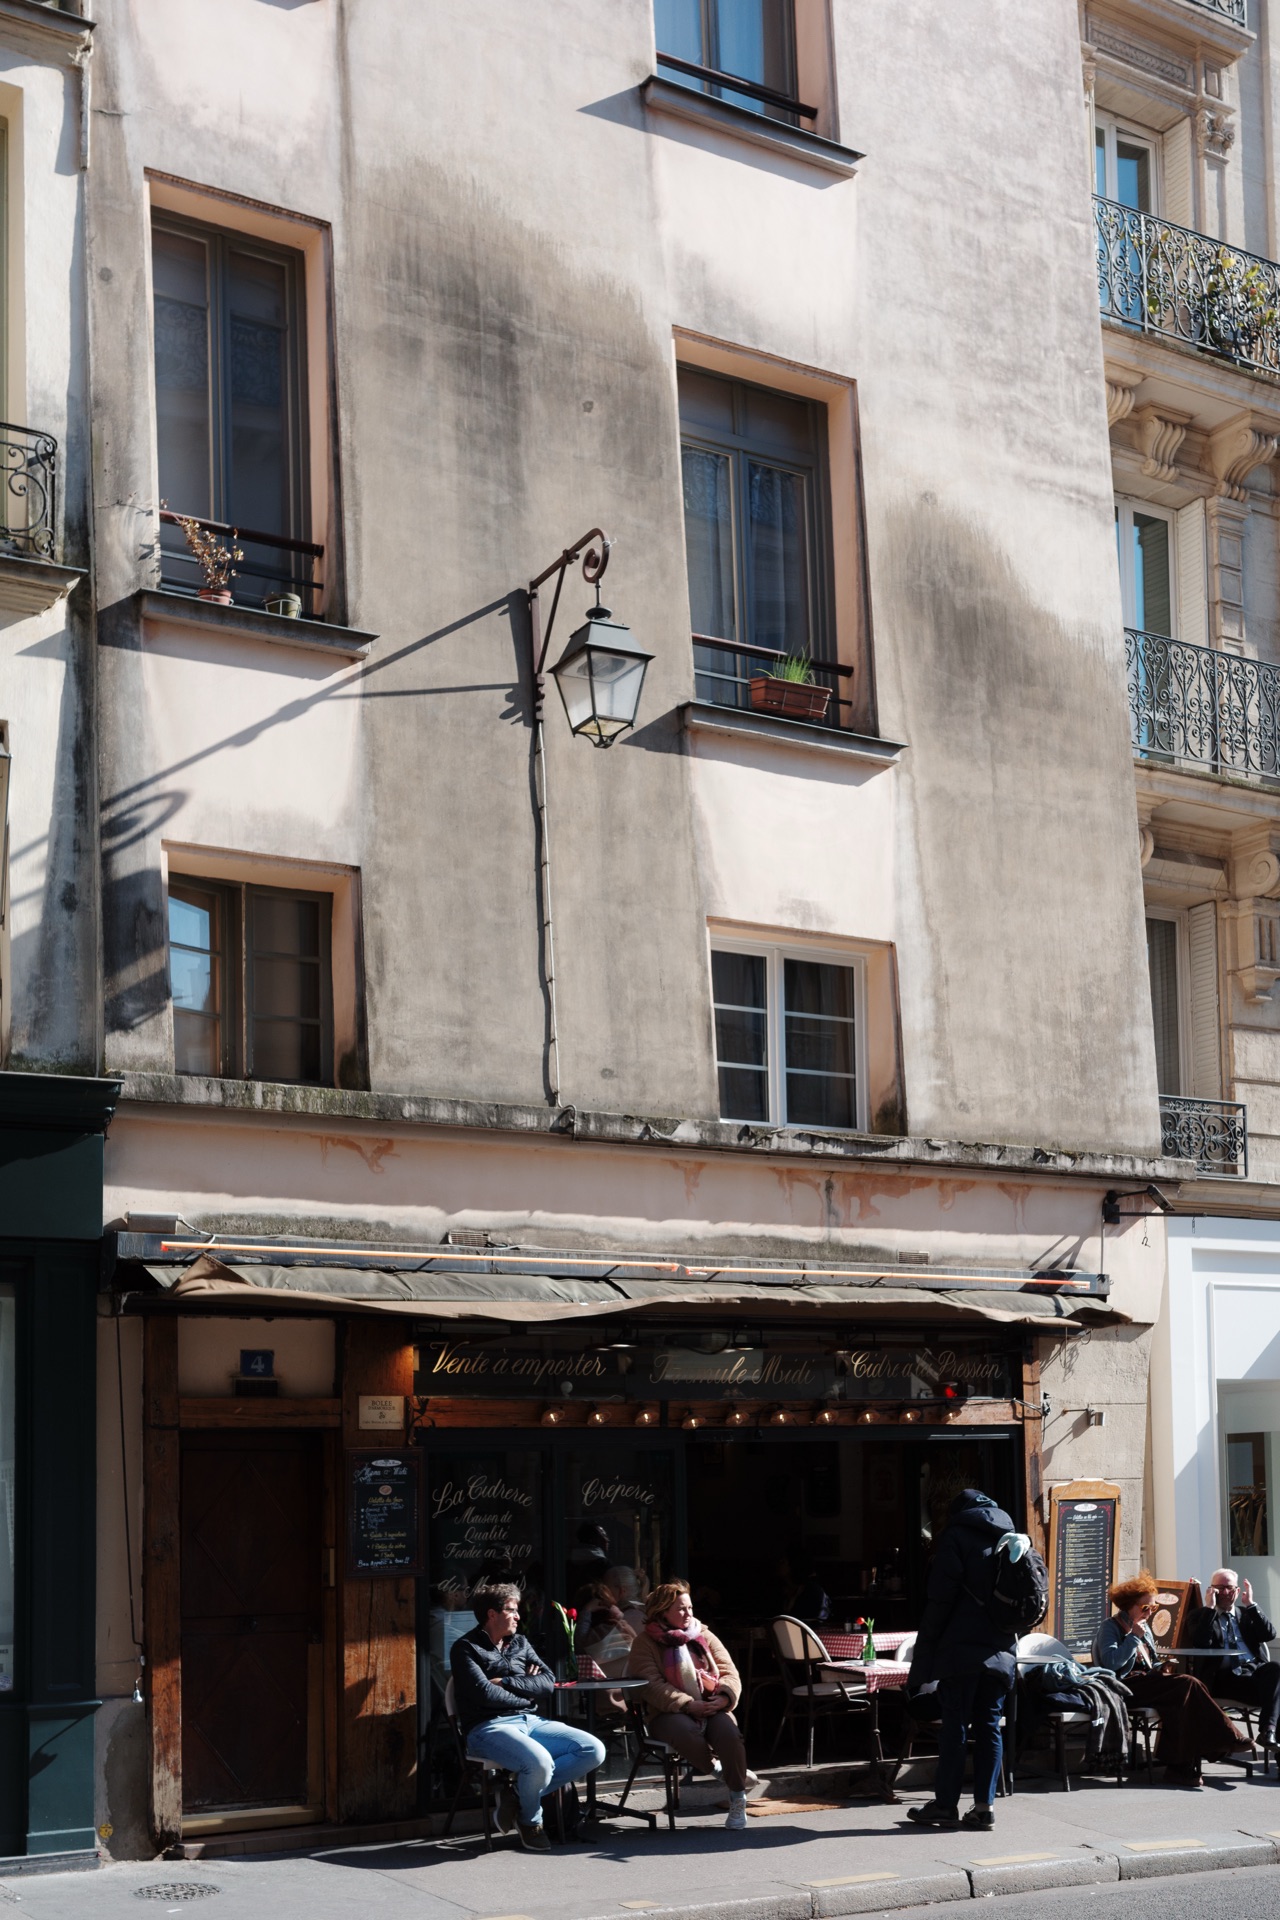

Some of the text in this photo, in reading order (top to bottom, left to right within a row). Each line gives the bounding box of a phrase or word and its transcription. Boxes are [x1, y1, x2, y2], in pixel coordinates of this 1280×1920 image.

[250, 1355, 265, 1373] 4
[430, 1341, 607, 1385] Vente à emporter
[751, 1354, 816, 1385] Midi
[851, 1350, 900, 1379] Cidre
[938, 1350, 1003, 1379] Pression
[432, 1481, 465, 1519] La
[467, 1475, 533, 1507] Cidrerie
[454, 1506, 513, 1525] Maison de
[464, 1525, 511, 1544] Qualité
[484, 1547, 497, 1558] en
[502, 1544, 532, 1559] 2009
[437, 1575, 461, 1593] du
